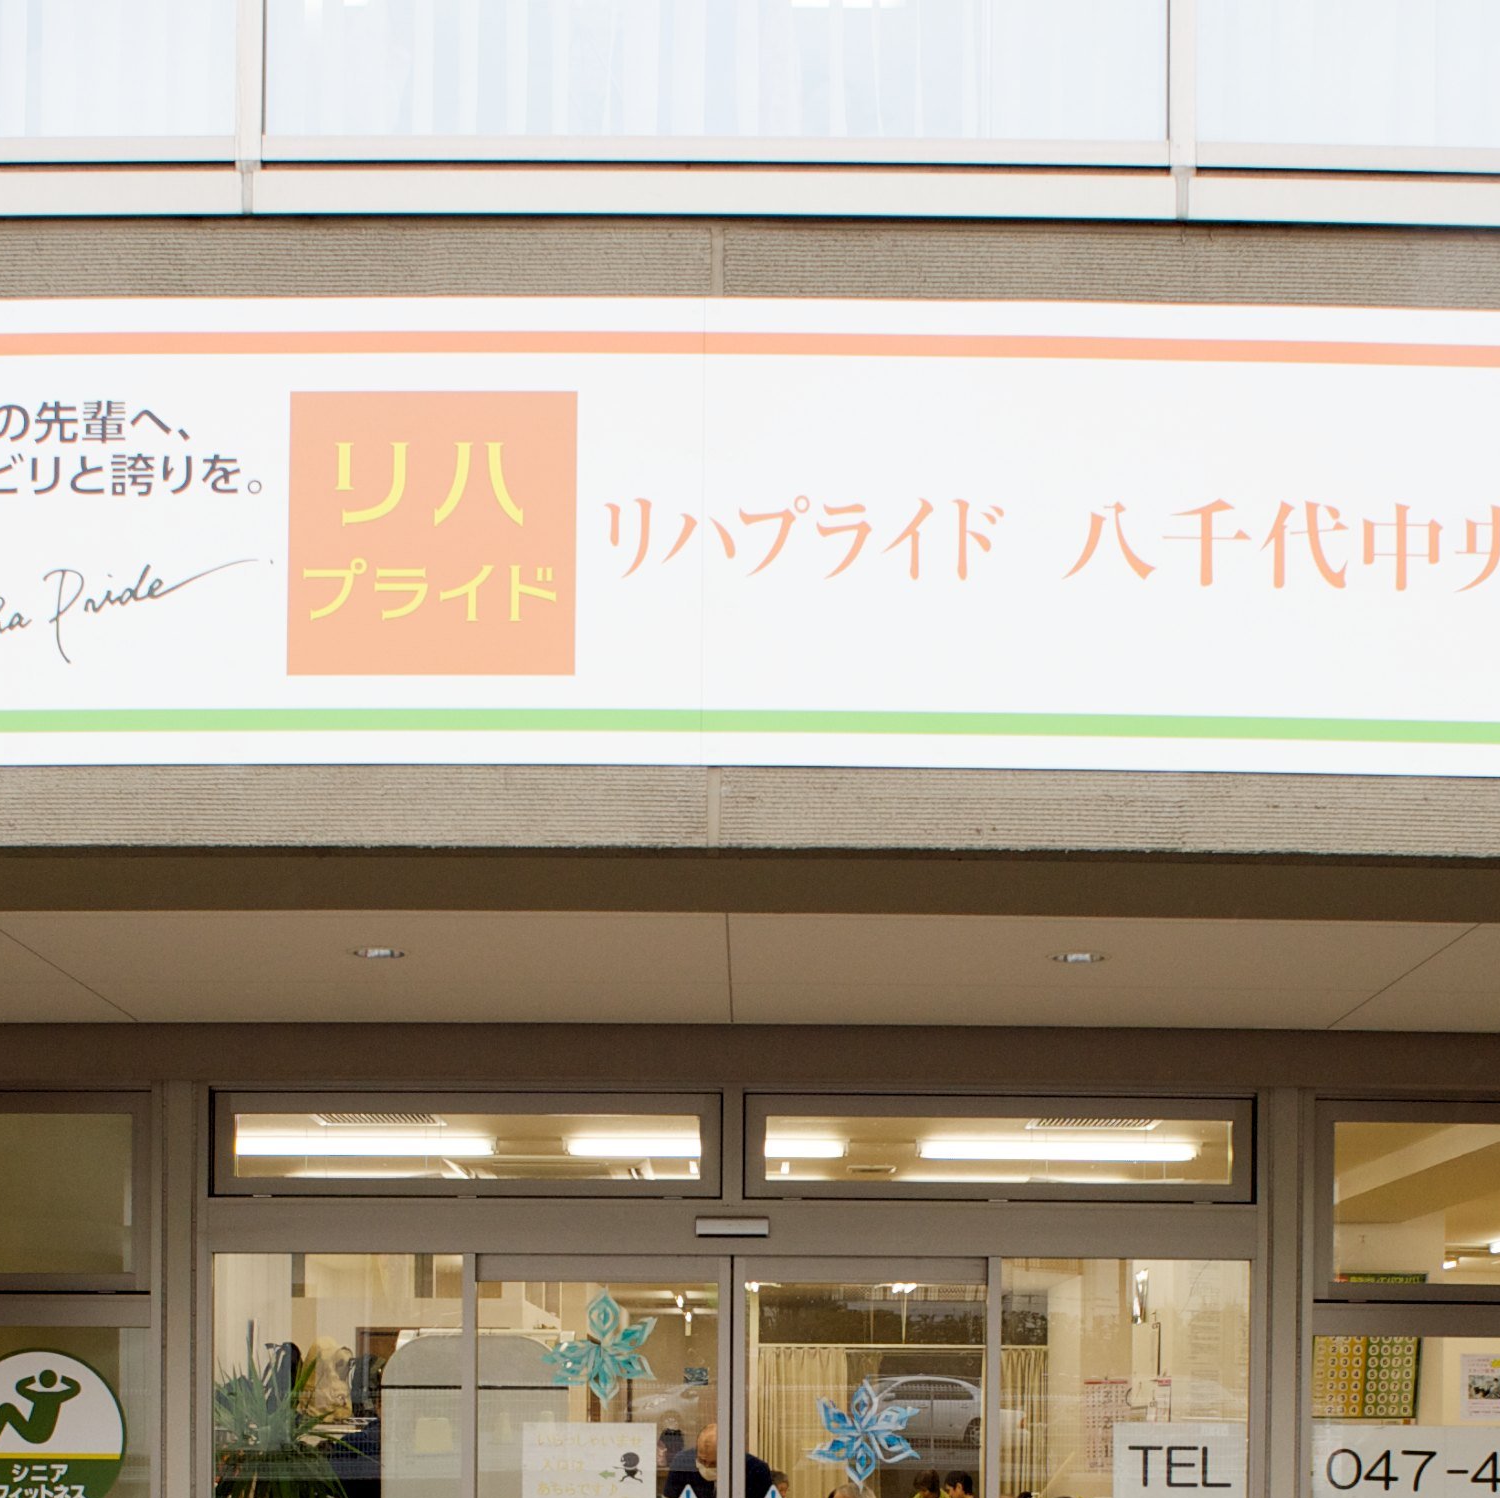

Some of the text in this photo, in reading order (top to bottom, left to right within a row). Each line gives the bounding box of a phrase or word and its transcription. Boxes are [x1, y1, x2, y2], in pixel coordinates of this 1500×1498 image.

[335, 442, 524, 527] リハ
[604, 495, 1005, 581] リハプライド
[43, 558, 260, 664] Pride
[302, 557, 557, 622] プライド
[11, 1463, 69, 1483] シニア
[1128, 1446, 1232, 1487] TEL
